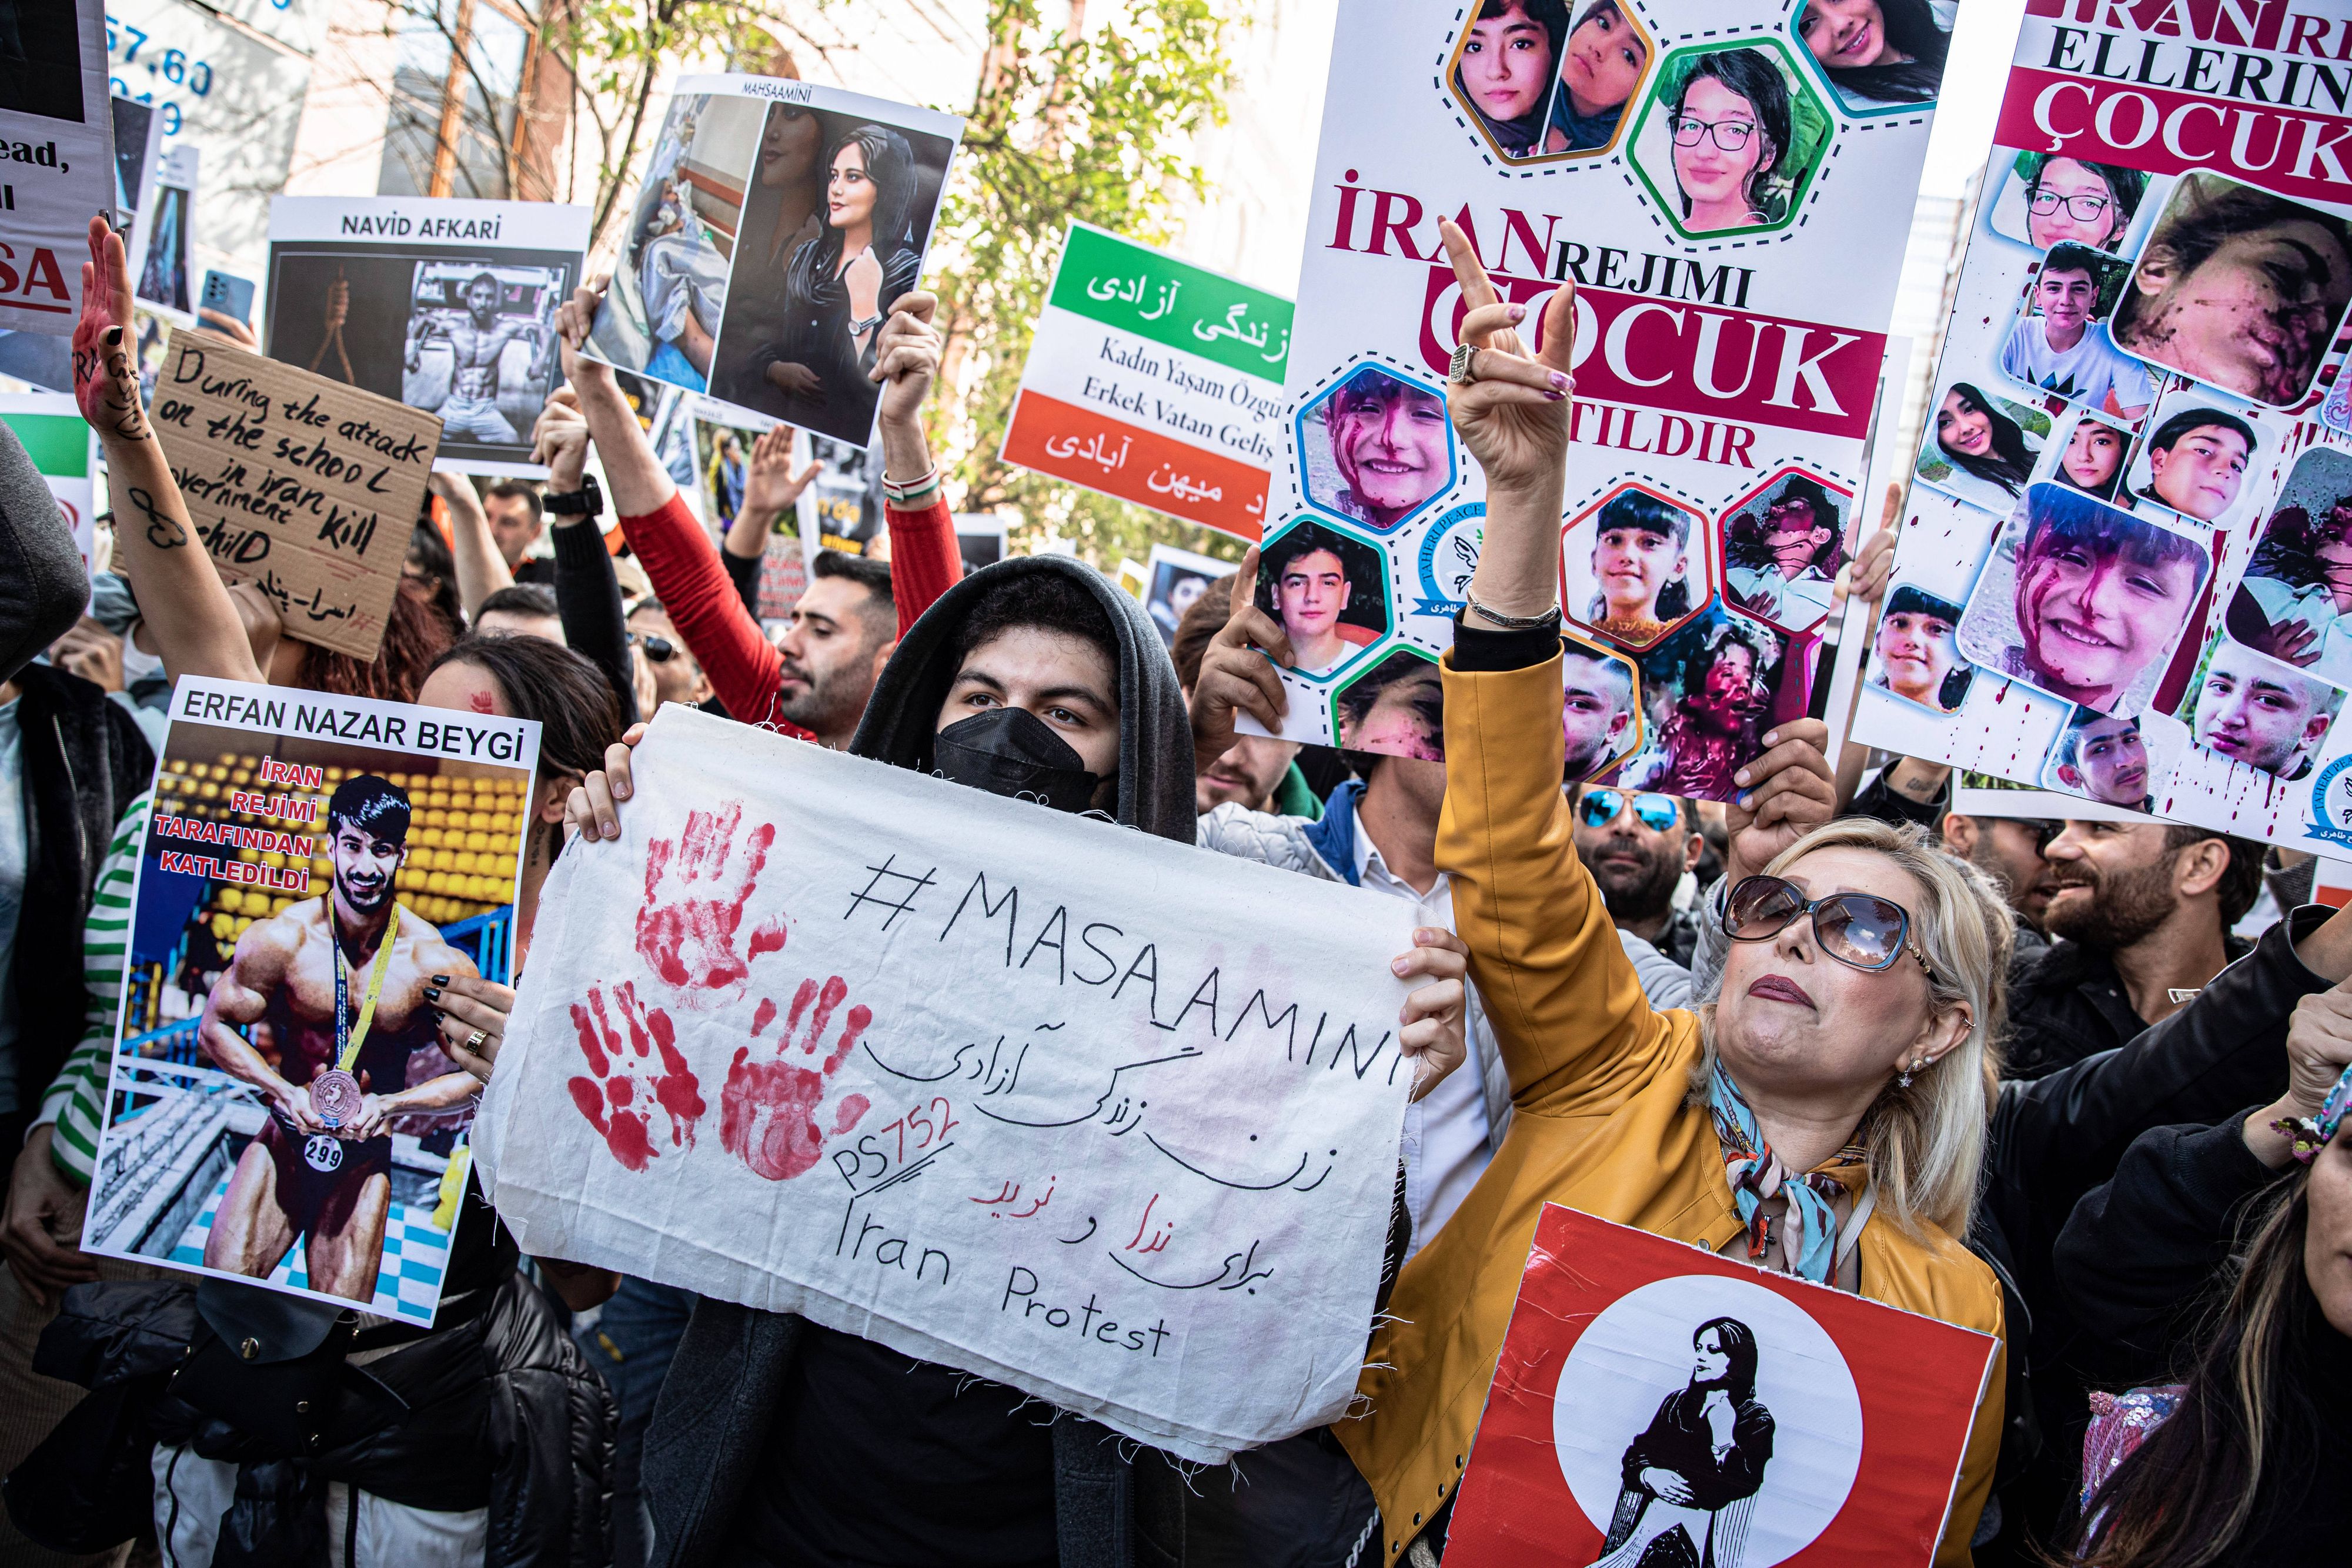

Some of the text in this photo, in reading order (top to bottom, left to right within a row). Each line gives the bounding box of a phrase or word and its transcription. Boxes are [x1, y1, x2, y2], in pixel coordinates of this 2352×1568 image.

[2033, 81, 2352, 185] ÇOCUK
[342, 210, 502, 240] NAVİD AFKARİ
[1325, 168, 1756, 309] İRAN REJIMI
[1086, 274, 1289, 363] زندگی آزادی
[1099, 336, 1159, 376] Kadın
[1167, 357, 1223, 399] Yaşam
[159, 399, 197, 427] on
[207, 411, 265, 450] the
[173, 346, 429, 463] During the attack
[1083, 376, 1147, 416] Erkek
[1155, 398, 1212, 439] Vatan
[222, 458, 323, 514] in iran
[1045, 432, 1222, 502] میهن آبادی
[1422, 503, 1482, 583] TAHERI PEACE
[183, 690, 526, 763] ERFAN NAZAR BEYGİ
[260, 755, 323, 788] İRAN
[2316, 770, 2334, 811] TAHERI
[153, 815, 313, 858] TARAFINDAN
[230, 791, 318, 823] REJİMİ
[160, 851, 310, 894] KATLEDİLDİ
[864, 1022, 1338, 1191] زن زندگی آزادی
[305, 1141, 341, 1168] 299
[836, 1196, 951, 1285] Iran
[968, 1176, 1274, 1294] برای ندا و نوید
[1001, 1266, 1171, 1358] Protest
